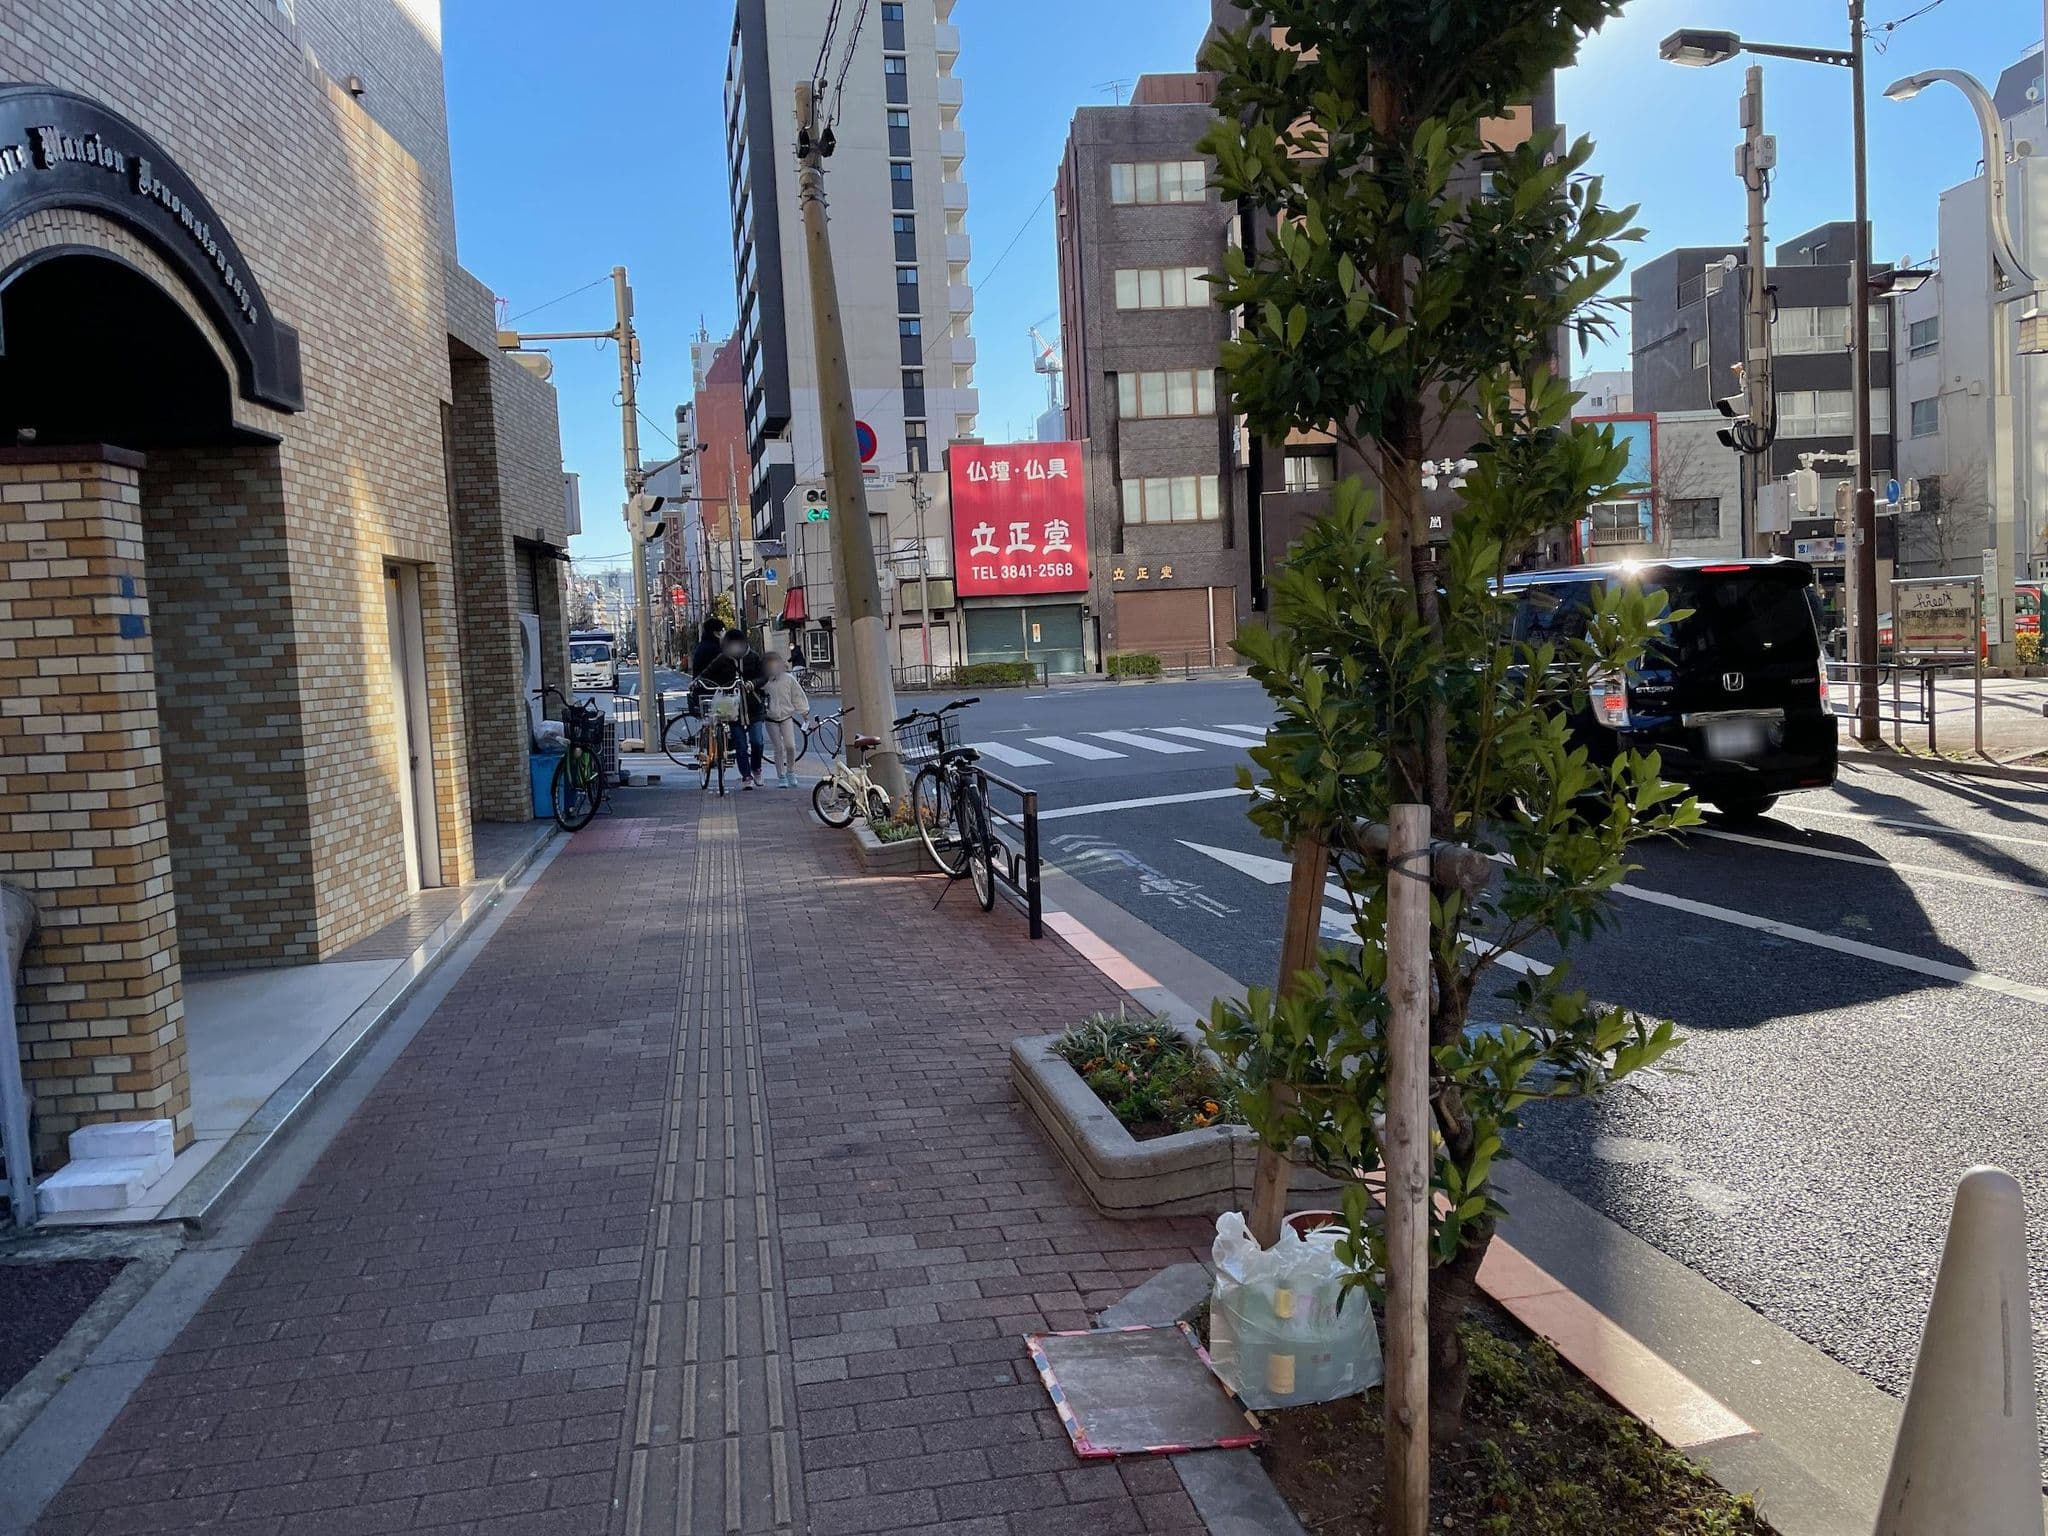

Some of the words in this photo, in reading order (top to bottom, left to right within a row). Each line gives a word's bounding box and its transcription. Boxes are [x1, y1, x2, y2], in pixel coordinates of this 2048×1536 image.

[38, 126, 125, 173] Mansion
[966, 458, 1068, 481] 仏壇・仏具
[970, 519, 1073, 557] 立正堂
[971, 565, 998, 580] TEL
[1000, 562, 1073, 579] 3841-2568
